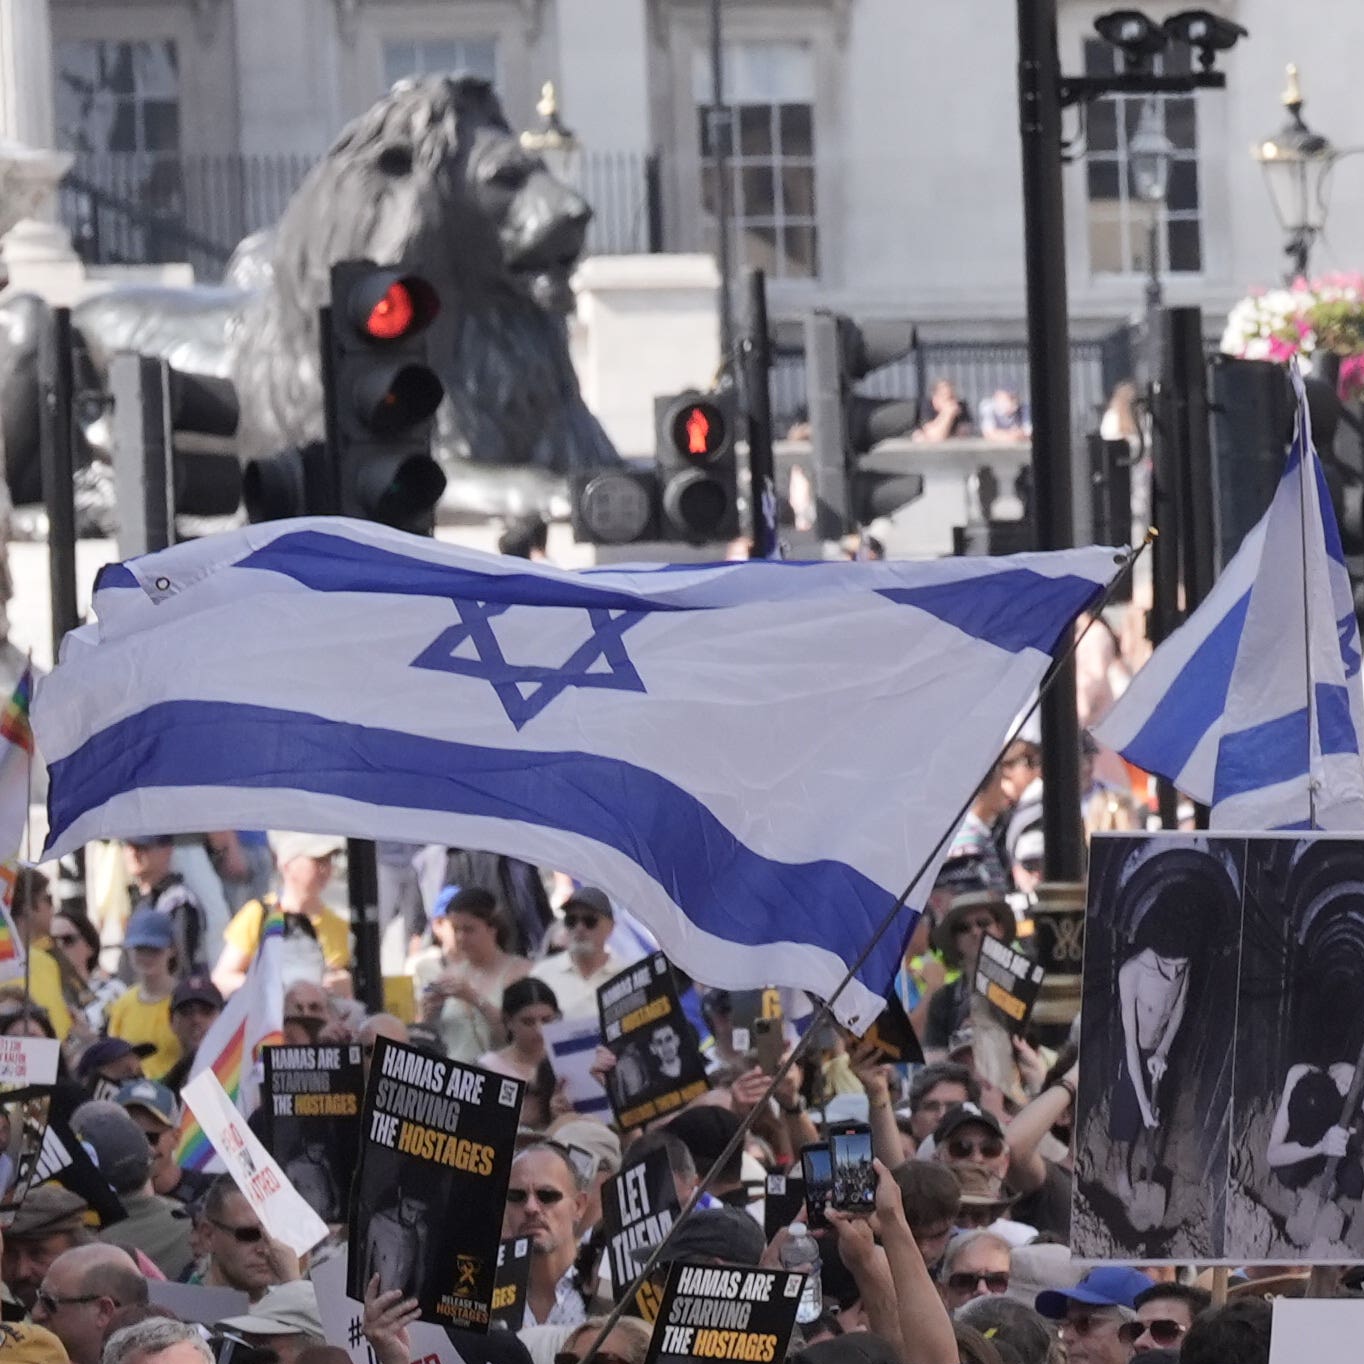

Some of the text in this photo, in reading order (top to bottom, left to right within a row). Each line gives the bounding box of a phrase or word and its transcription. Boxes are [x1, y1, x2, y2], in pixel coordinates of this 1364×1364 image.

[271, 1047, 342, 1070] HAMAS ARE
[381, 1044, 486, 1106] HAMAS ARE
[273, 1094, 358, 1117] THE HOSTAGES
[375, 1078, 462, 1134] STARVING
[369, 1110, 496, 1178] THE HOSTAGES
[617, 1162, 649, 1227] LET
[677, 1267, 775, 1302] HAMAS ARE
[669, 1296, 751, 1330] STARVING
[662, 1326, 778, 1362] THE HOSTAGES
